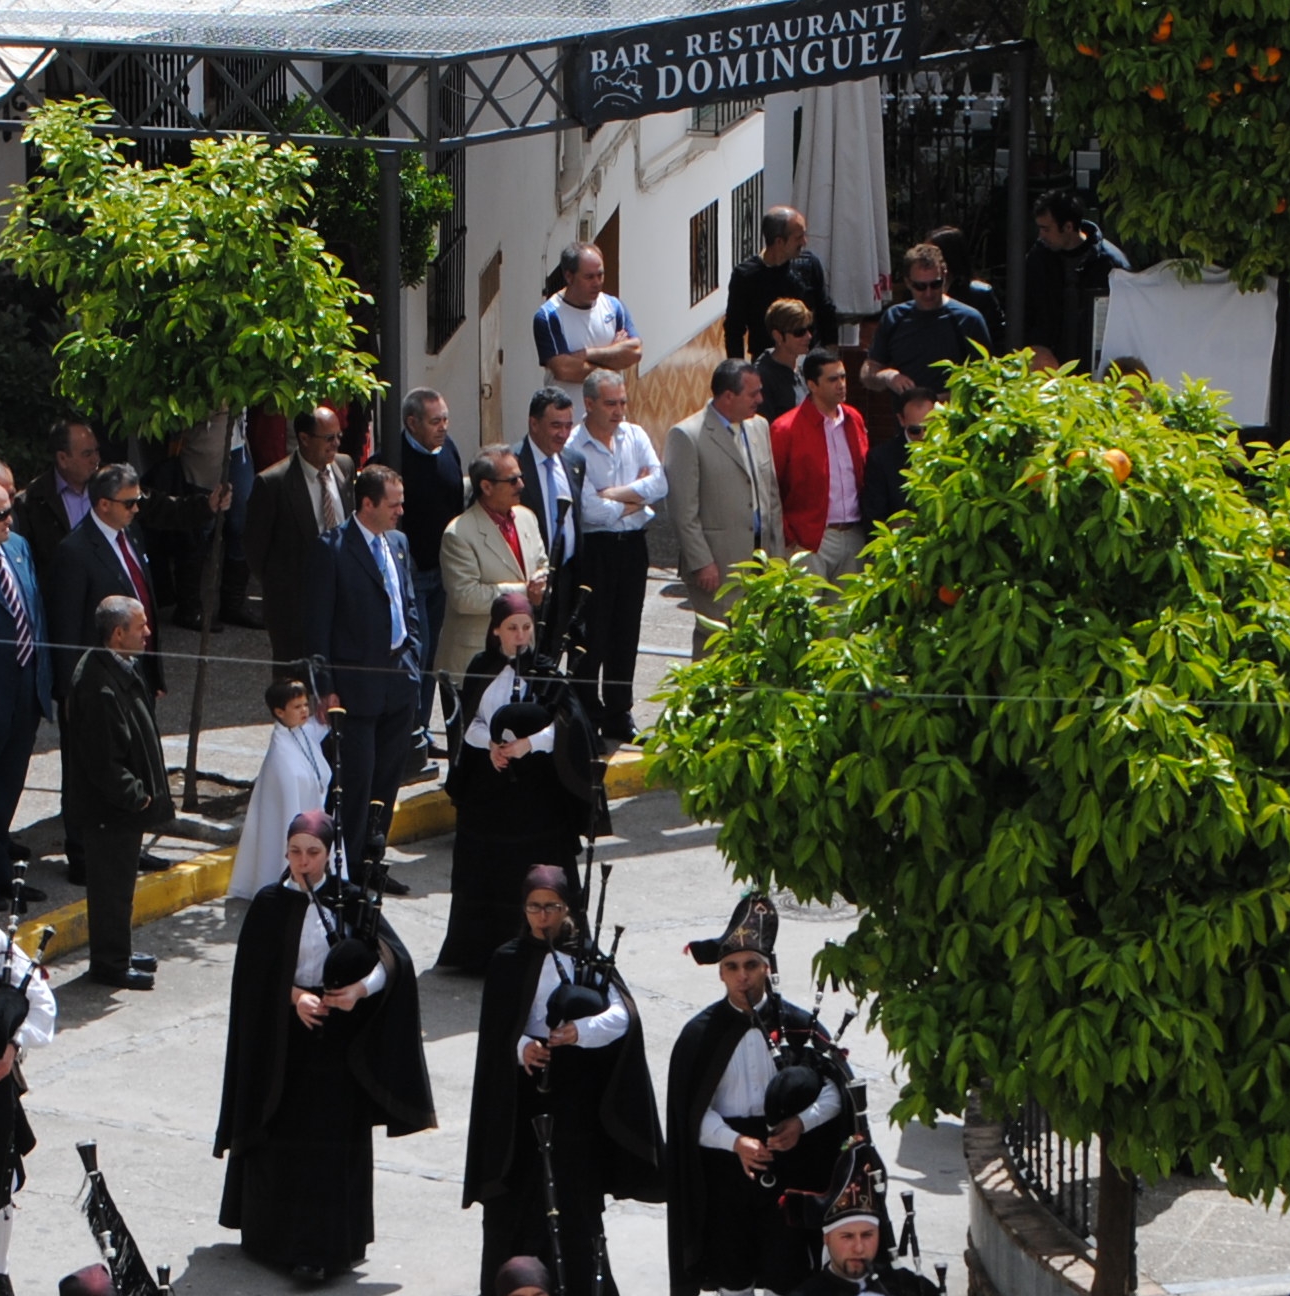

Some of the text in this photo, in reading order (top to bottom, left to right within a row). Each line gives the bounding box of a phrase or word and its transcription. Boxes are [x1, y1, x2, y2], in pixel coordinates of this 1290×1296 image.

[590, 42, 652, 73] BAR
[685, 1, 907, 57] RESTAURANTE
[656, 27, 903, 100] DOMINGUEZ
